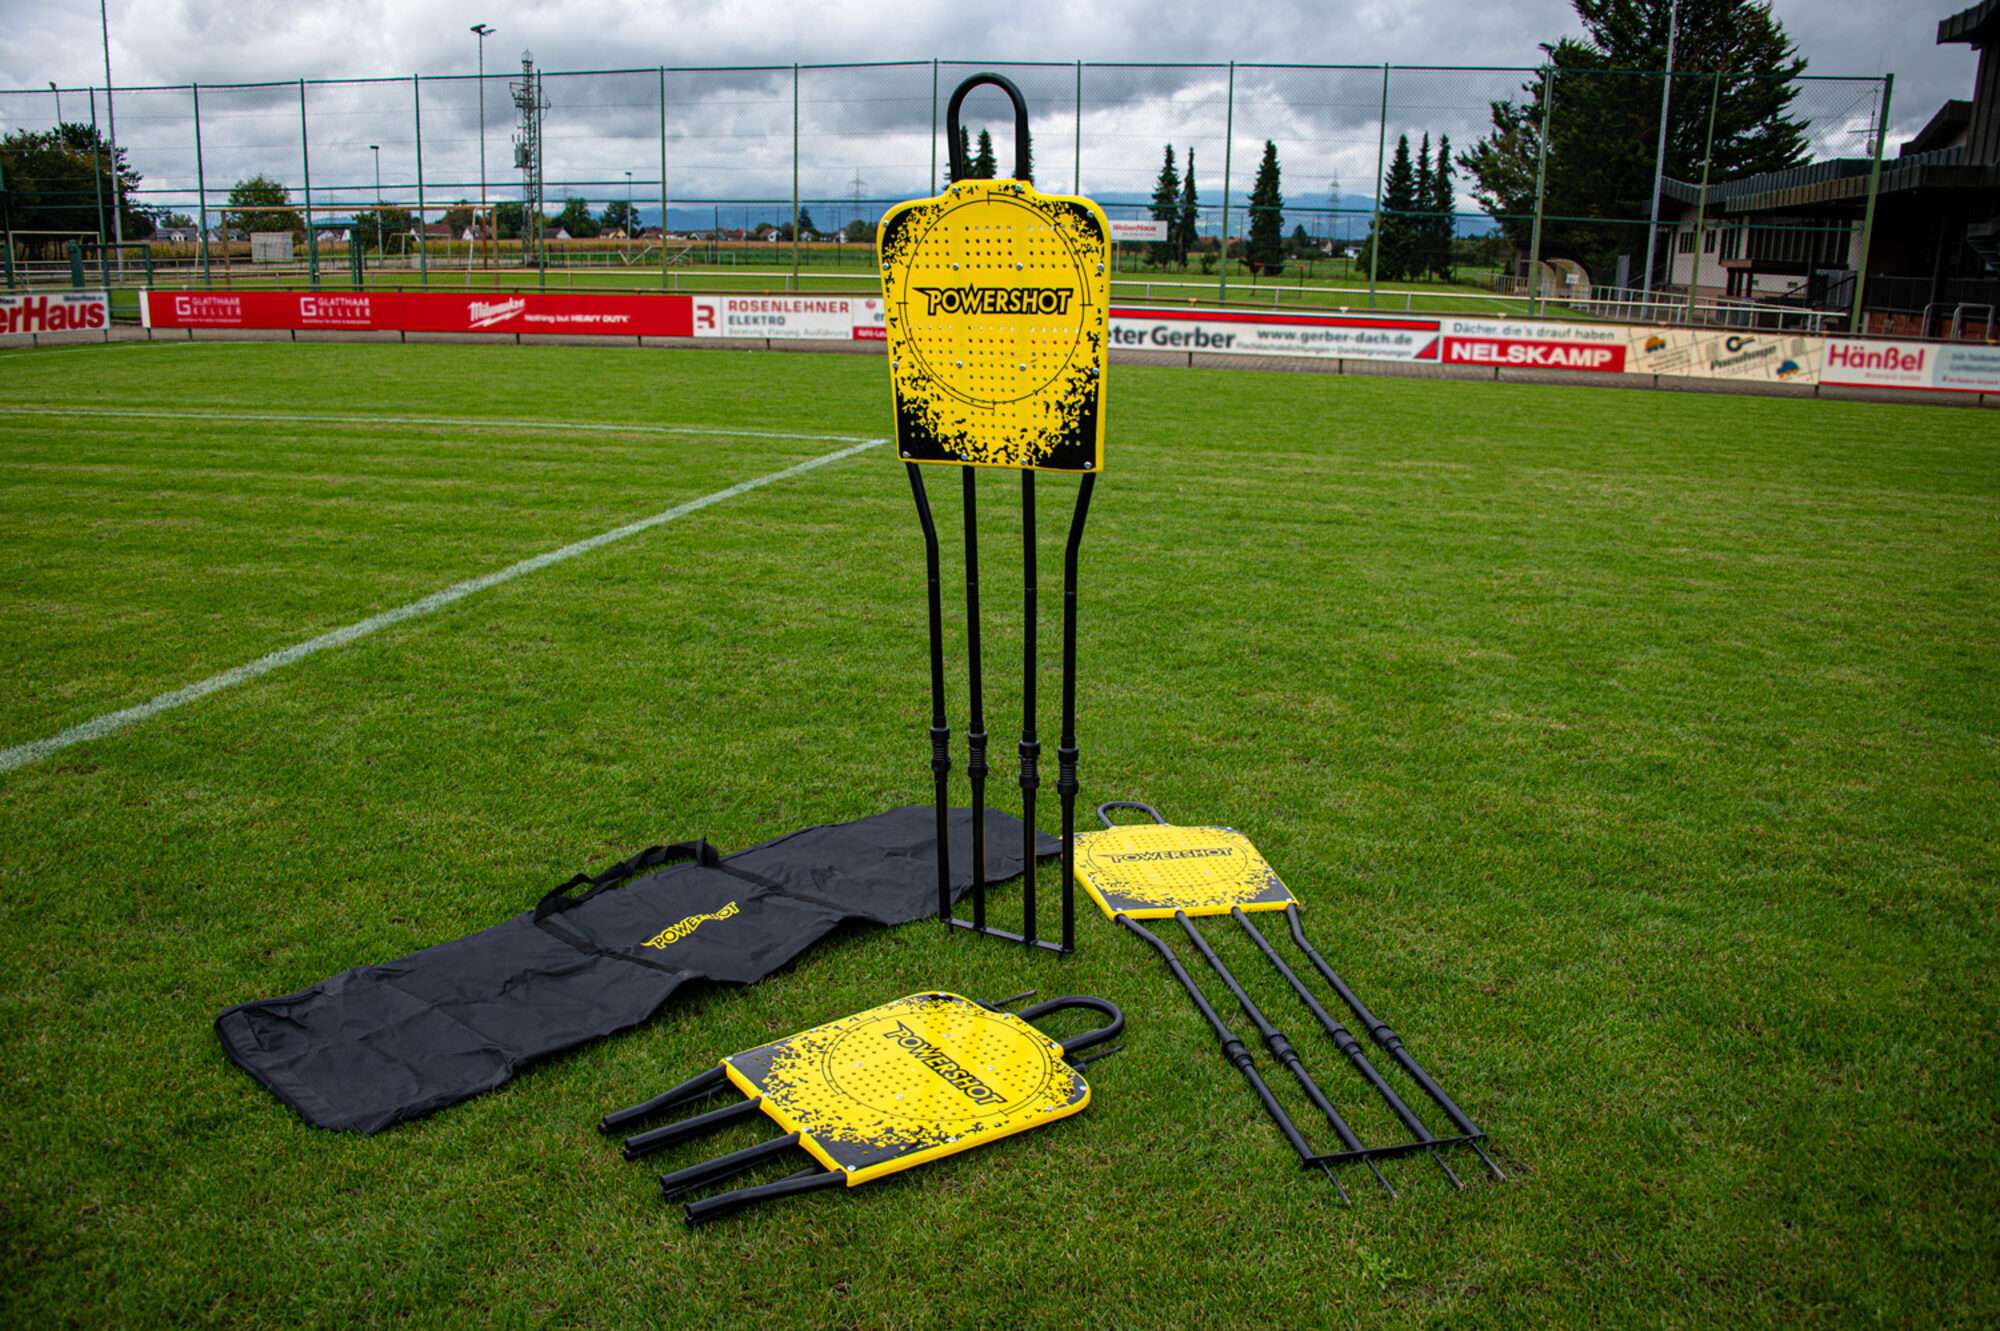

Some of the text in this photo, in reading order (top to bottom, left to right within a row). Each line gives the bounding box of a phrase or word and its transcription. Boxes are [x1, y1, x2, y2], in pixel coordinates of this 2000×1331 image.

[728, 300, 849, 313] ROSENLEHNER
[912, 282, 1074, 315] POWERSHOT
[319, 307, 371, 317] KELLER
[571, 315, 601, 323] HEAVY
[728, 315, 786, 326] ELEKTRO
[1108, 324, 1237, 349] ter Gerber
[1257, 329, 1413, 346] www.gerber-dach.de
[1536, 326, 1572, 339] drauf
[1575, 330, 1616, 341] haben
[1451, 341, 1614, 368] NELSKAMP
[1827, 343, 1925, 371] Hänßel
[1097, 847, 1233, 863] POWERSHOT
[640, 901, 740, 950] POWEOT
[883, 1019, 1008, 1106] POWERSHOT
